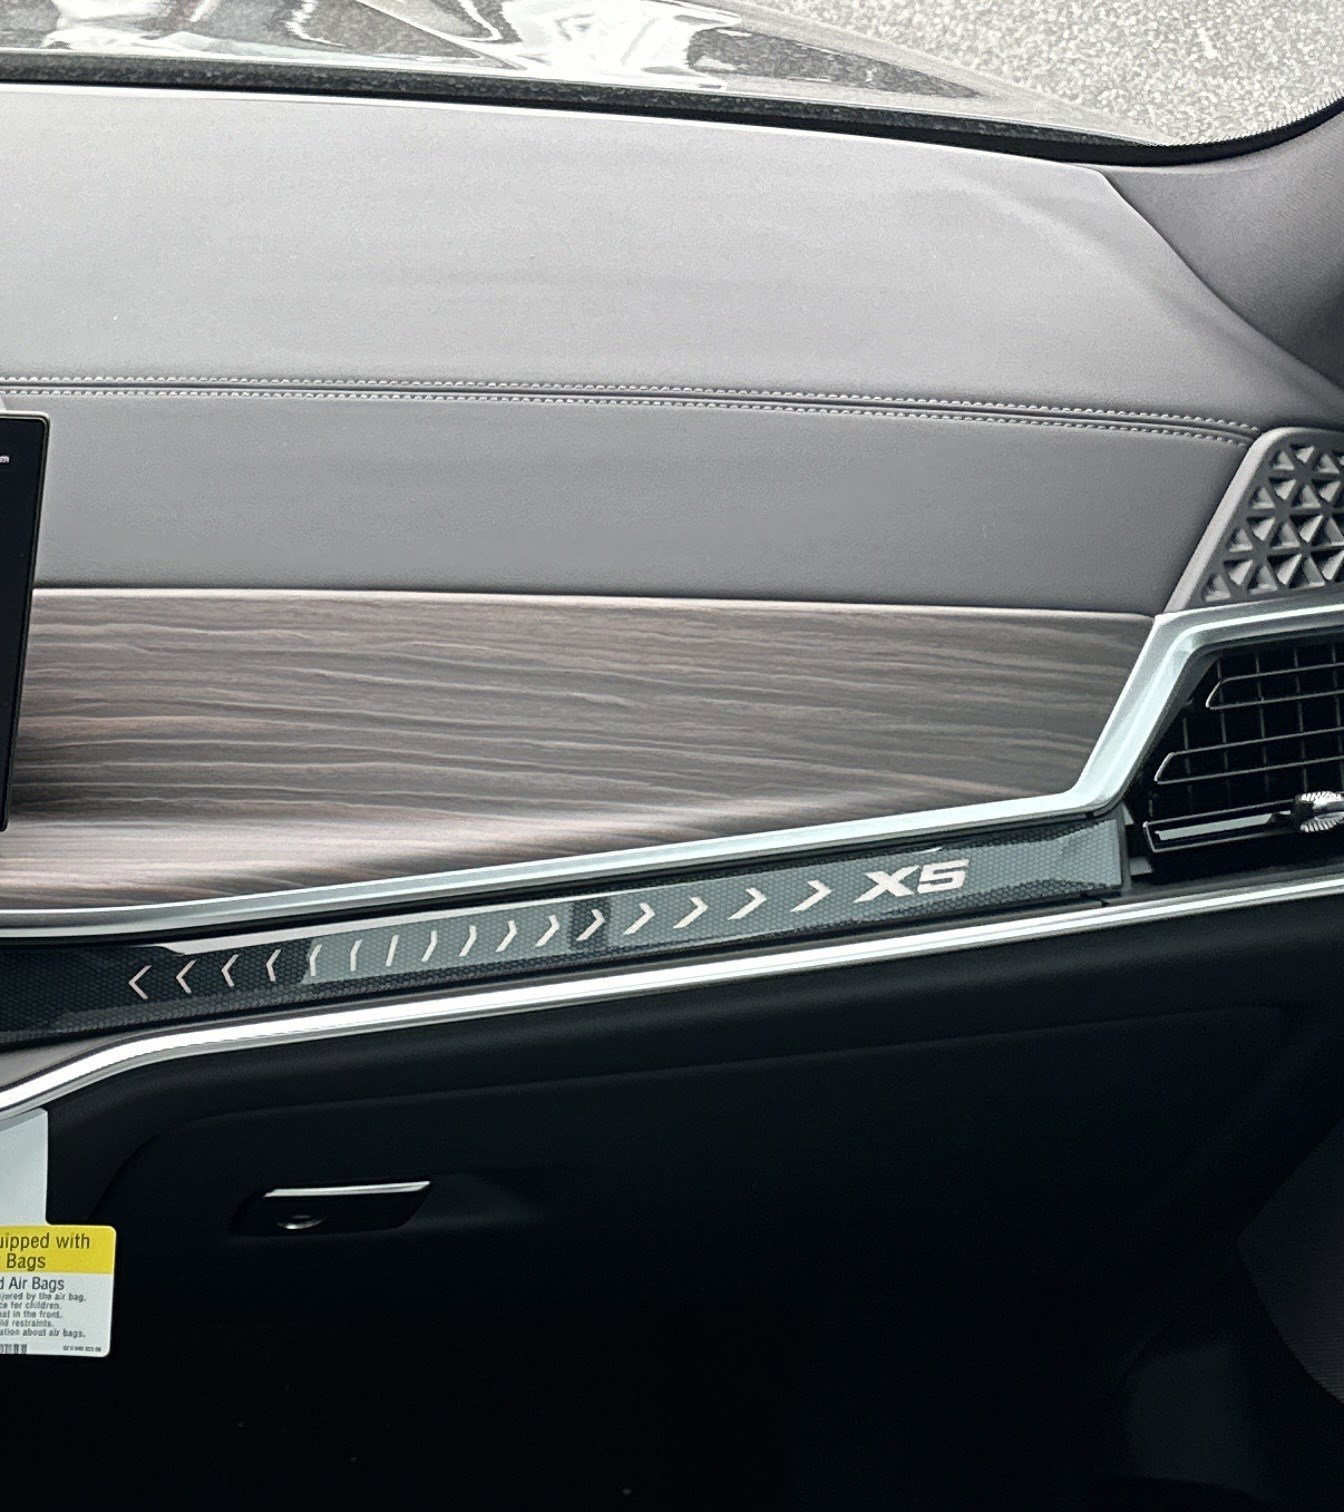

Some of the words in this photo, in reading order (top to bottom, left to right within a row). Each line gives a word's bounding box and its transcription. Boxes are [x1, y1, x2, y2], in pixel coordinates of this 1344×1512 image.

[853, 858, 970, 903] X5
[56, 1232, 90, 1249] with
[7, 1252, 46, 1271] Bags
[9, 1276, 28, 1290] Air
[32, 1276, 65, 1293] Bags
[39, 1292, 51, 1300] the
[11, 1301, 22, 1309] for
[23, 1310, 36, 1318] the
[22, 1328, 46, 1336] about
